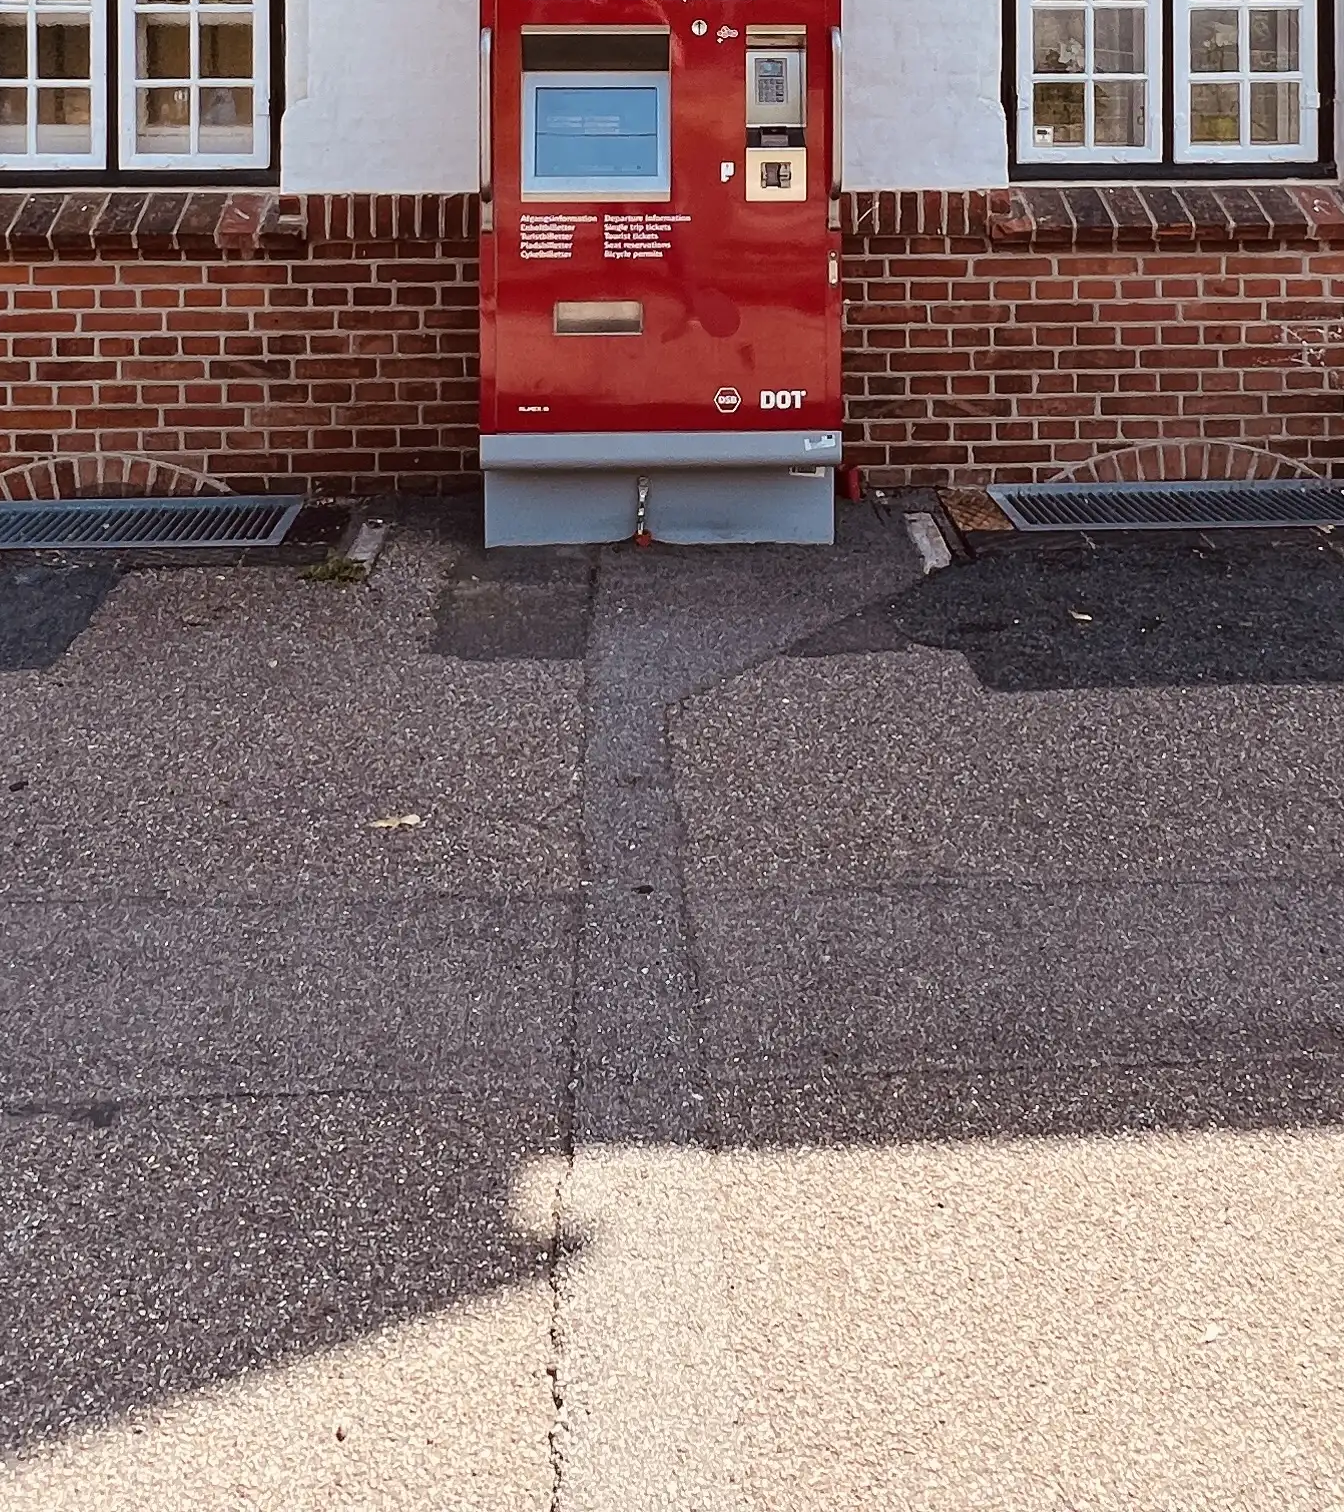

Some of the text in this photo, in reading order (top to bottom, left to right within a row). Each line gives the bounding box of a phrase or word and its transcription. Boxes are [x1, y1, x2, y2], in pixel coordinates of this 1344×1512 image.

[604, 214, 644, 224] Departure
[604, 223, 672, 233] Single trip tickets
[604, 231, 659, 240] Tourist tickets
[604, 240, 622, 249] Seat
[604, 249, 632, 259] Bicycle
[760, 390, 808, 410] DOT
